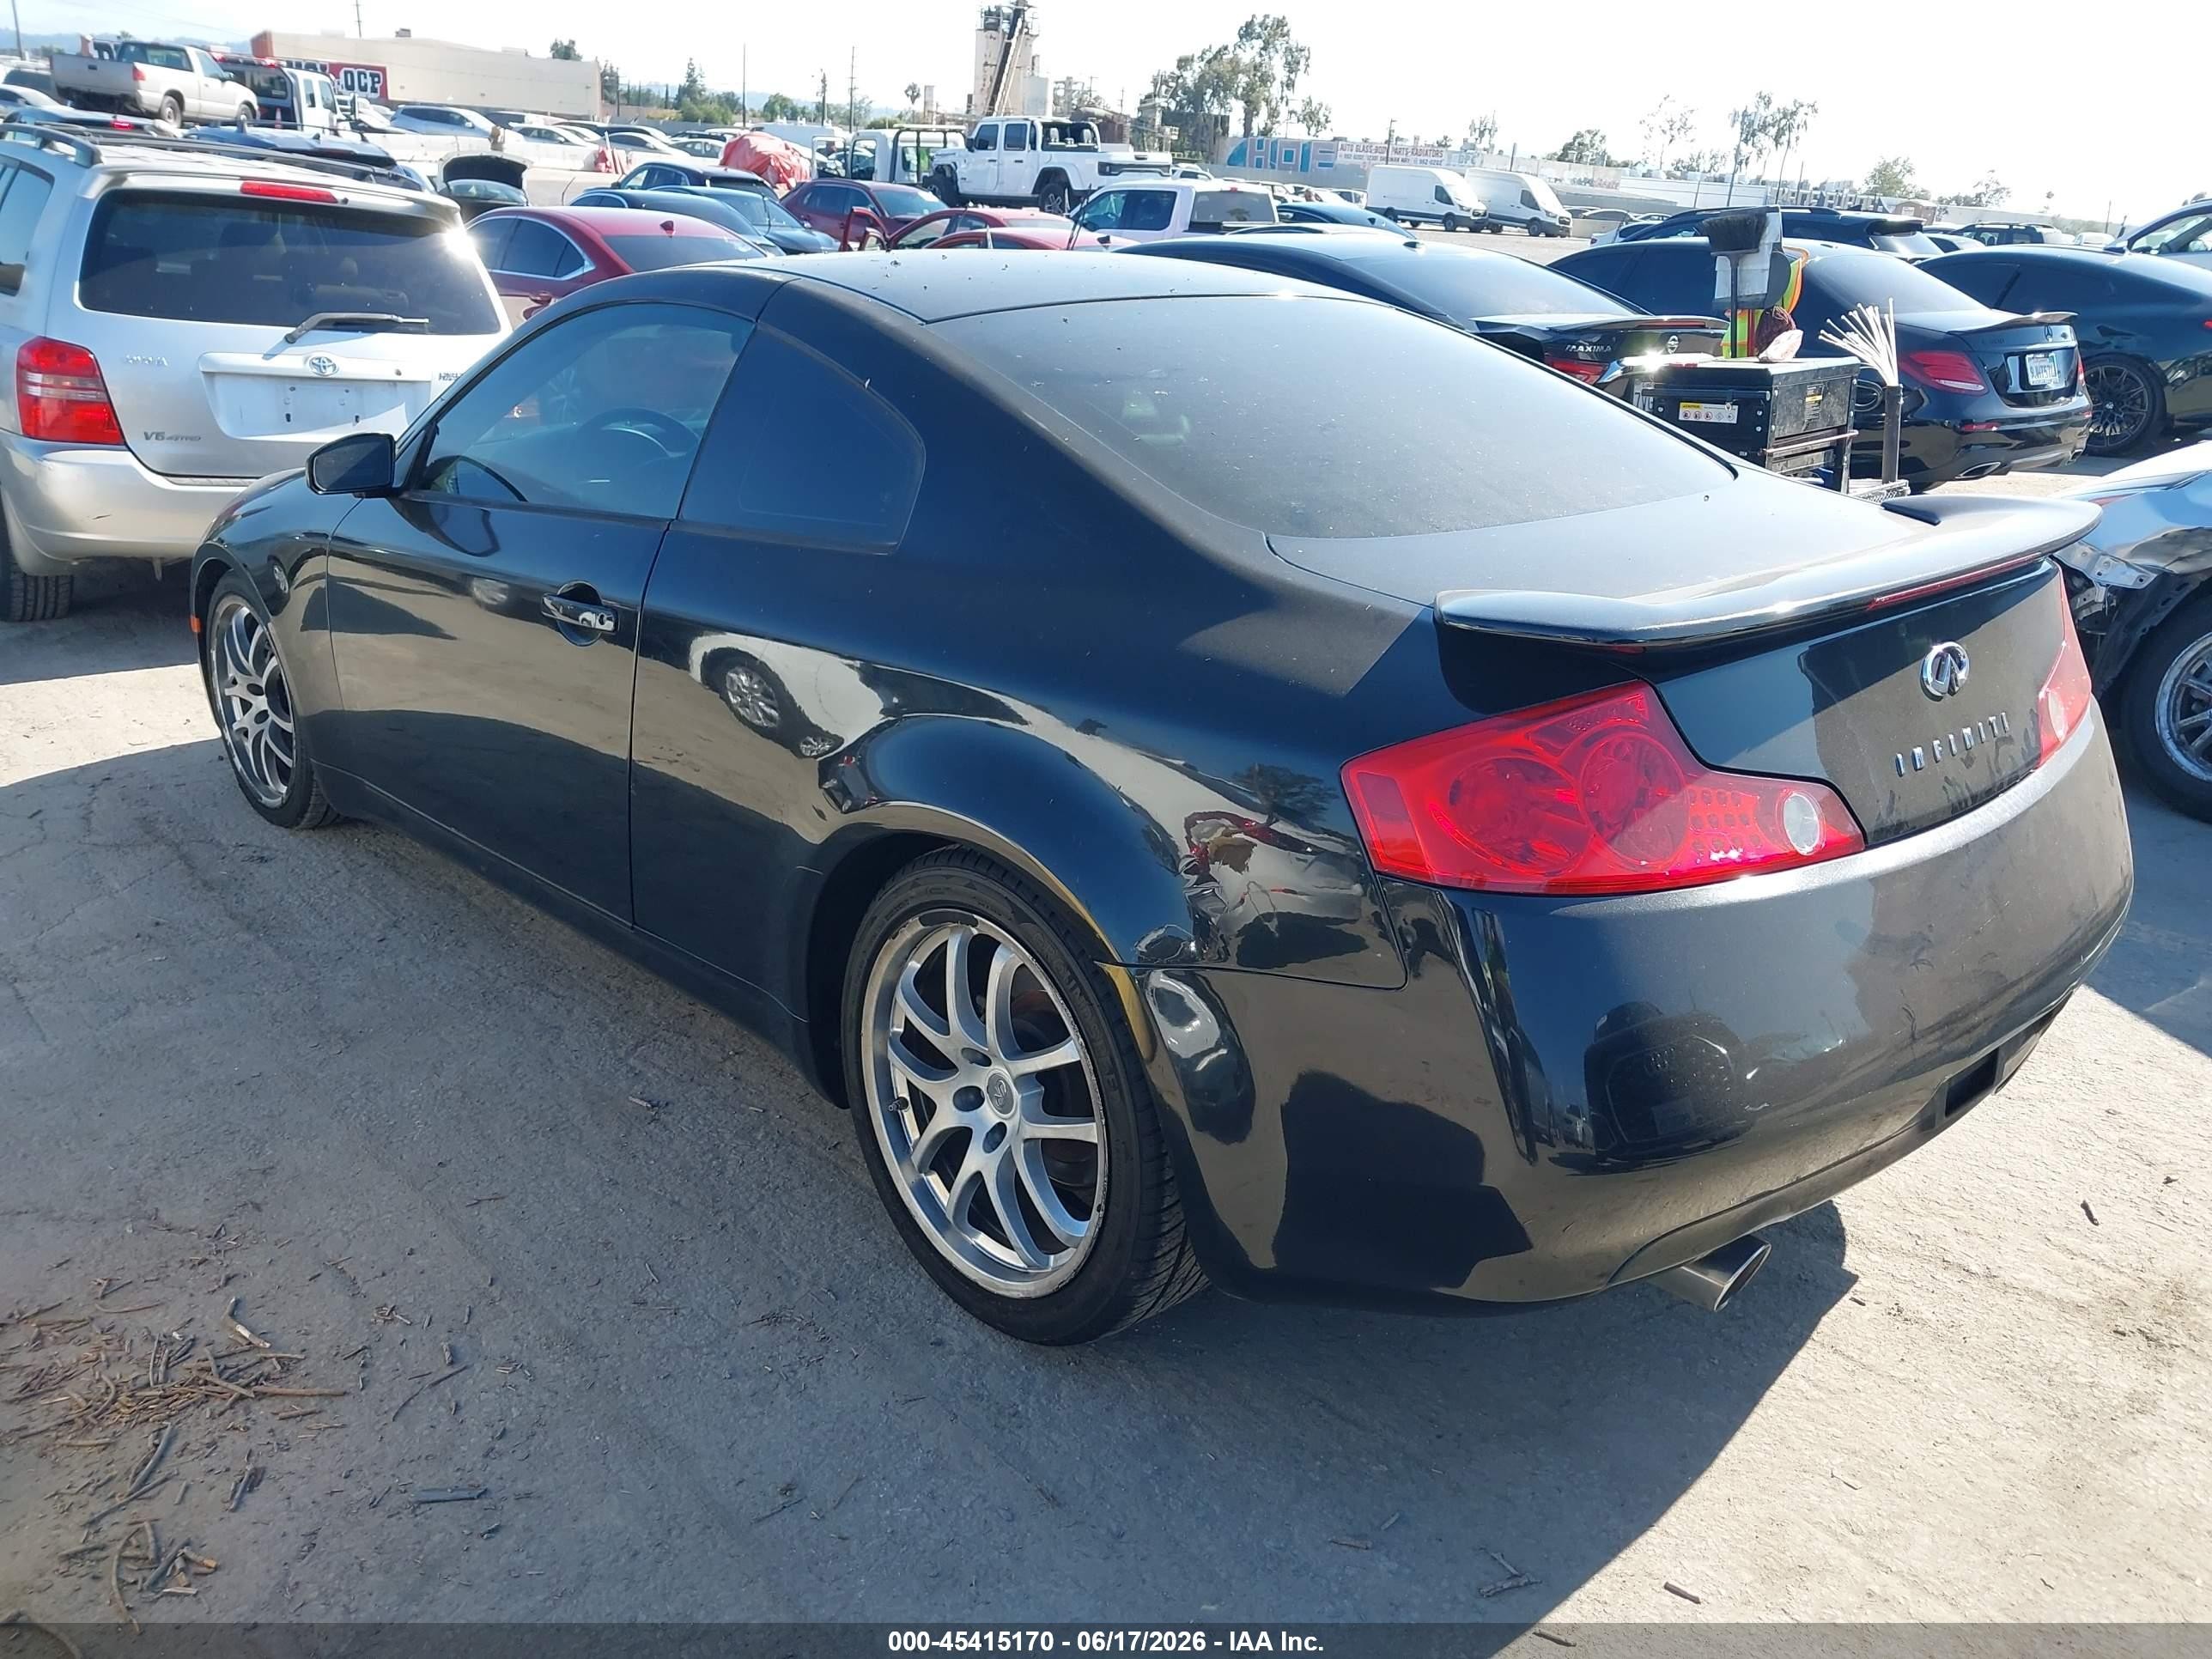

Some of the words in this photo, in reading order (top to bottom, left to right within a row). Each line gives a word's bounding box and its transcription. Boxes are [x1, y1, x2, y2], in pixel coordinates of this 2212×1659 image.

[1340, 143, 1354, 152] AUTO
[143, 431, 166, 441] V6
[1895, 712, 2009, 777] INFINITI
